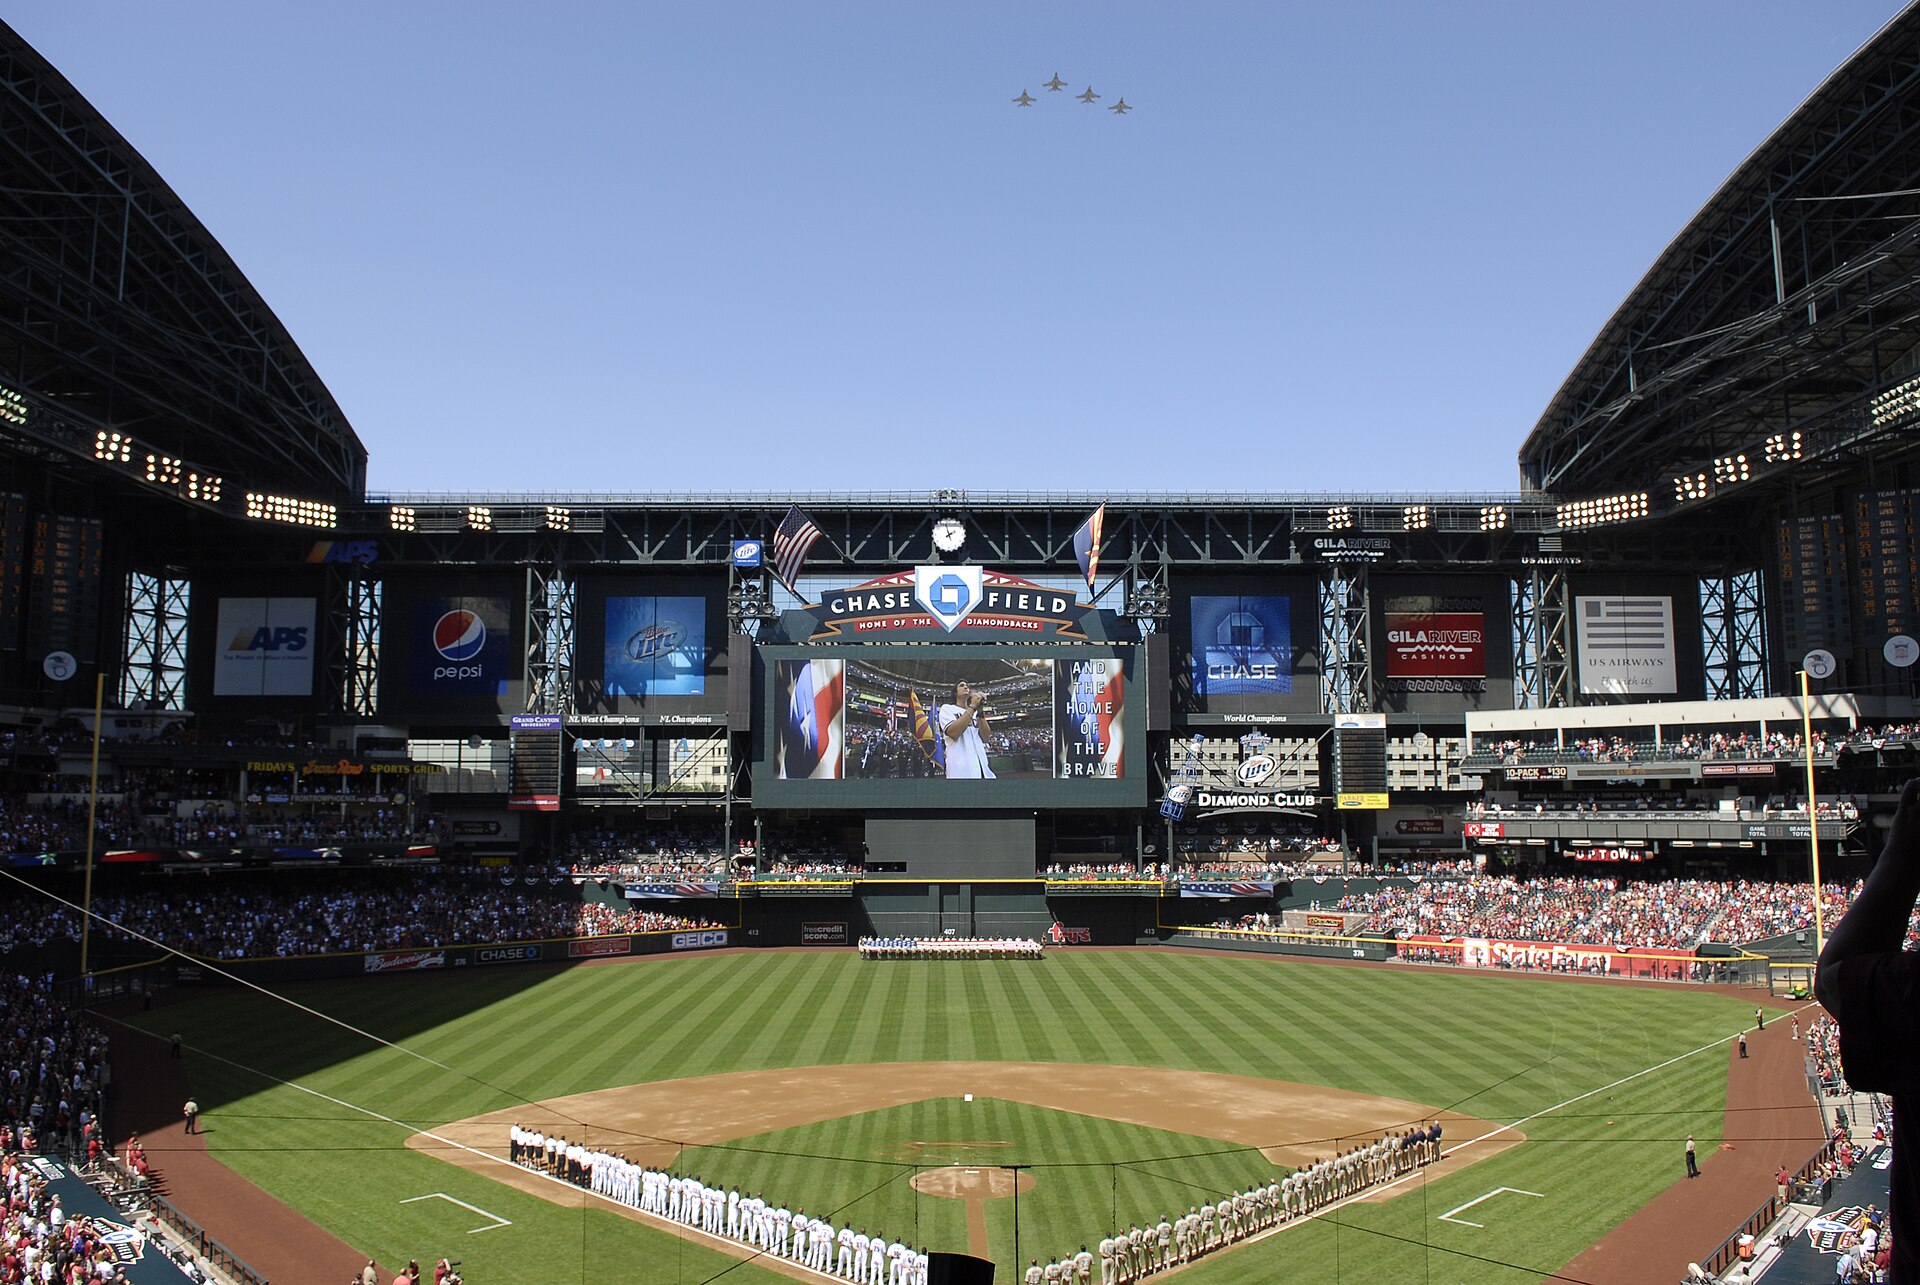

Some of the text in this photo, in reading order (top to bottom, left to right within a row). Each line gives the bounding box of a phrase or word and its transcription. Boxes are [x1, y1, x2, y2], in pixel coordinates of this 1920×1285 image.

[1314, 538, 1390, 549] GILA RIVER
[323, 540, 380, 564] APS
[1883, 566, 1897, 574] PIT
[831, 592, 910, 614] CHASE
[988, 592, 1067, 613] FIELD
[859, 618, 931, 630] HOME OF THE
[966, 618, 1038, 630] DIAMONDBACKS
[248, 627, 309, 651] APS
[1387, 630, 1481, 643] GILA RIVER
[635, 632, 679, 660] Lite
[1073, 661, 1106, 675] AND
[1609, 658, 1664, 666] AIRWAYS
[434, 664, 482, 681] pepsi
[1207, 665, 1277, 679] CHASE
[1073, 681, 1105, 695] THE
[1066, 701, 1113, 715] HOME
[568, 715, 640, 724] NL West Champions
[659, 715, 712, 724] NL Champions
[1223, 714, 1287, 724] World Champions
[1080, 721, 1099, 735] OF
[1074, 742, 1106, 755] THE
[370, 764, 410, 773] SPORTS
[413, 764, 443, 773] GRILL
[1063, 762, 1118, 776] BRAVE
[1506, 767, 1566, 777] 10-PACK $130
[1198, 792, 1316, 806] DIAMOND CLUB
[1339, 795, 1365, 803] PARKER
[1576, 847, 1639, 860] UPTOWN
[804, 925, 843, 933] freecredit
[943, 928, 956, 936] 407
[1144, 928, 1155, 936] 413
[674, 931, 727, 948] GEICO
[480, 948, 524, 961] CHASE
[1493, 942, 1611, 972] State Farm
[371, 952, 432, 972] Budweiser
[1835, 1210, 1859, 1224] FIELD
[1820, 1231, 1837, 1248] CHASE
[115, 1242, 134, 1259] FIELD
